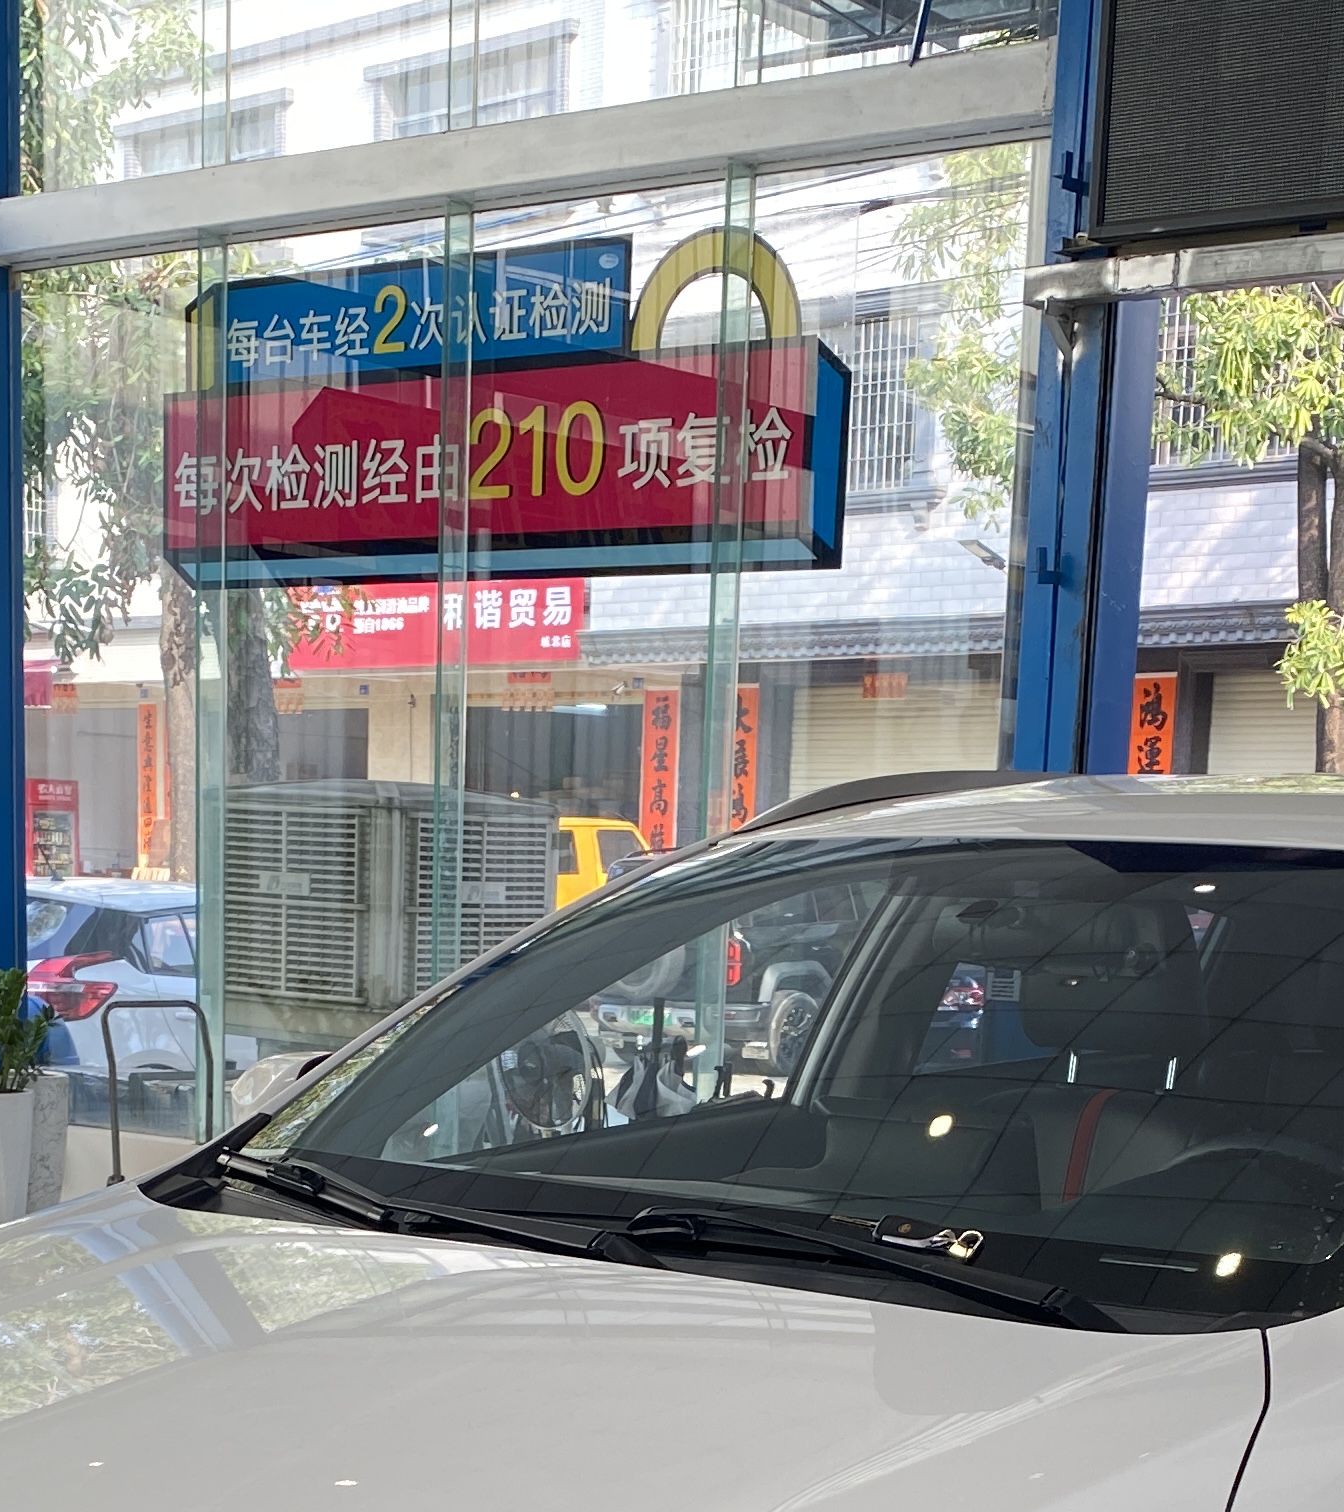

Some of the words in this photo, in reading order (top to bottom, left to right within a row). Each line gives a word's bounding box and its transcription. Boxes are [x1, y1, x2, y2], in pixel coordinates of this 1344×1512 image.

[226, 280, 611, 370] 每台车经2次认证检测
